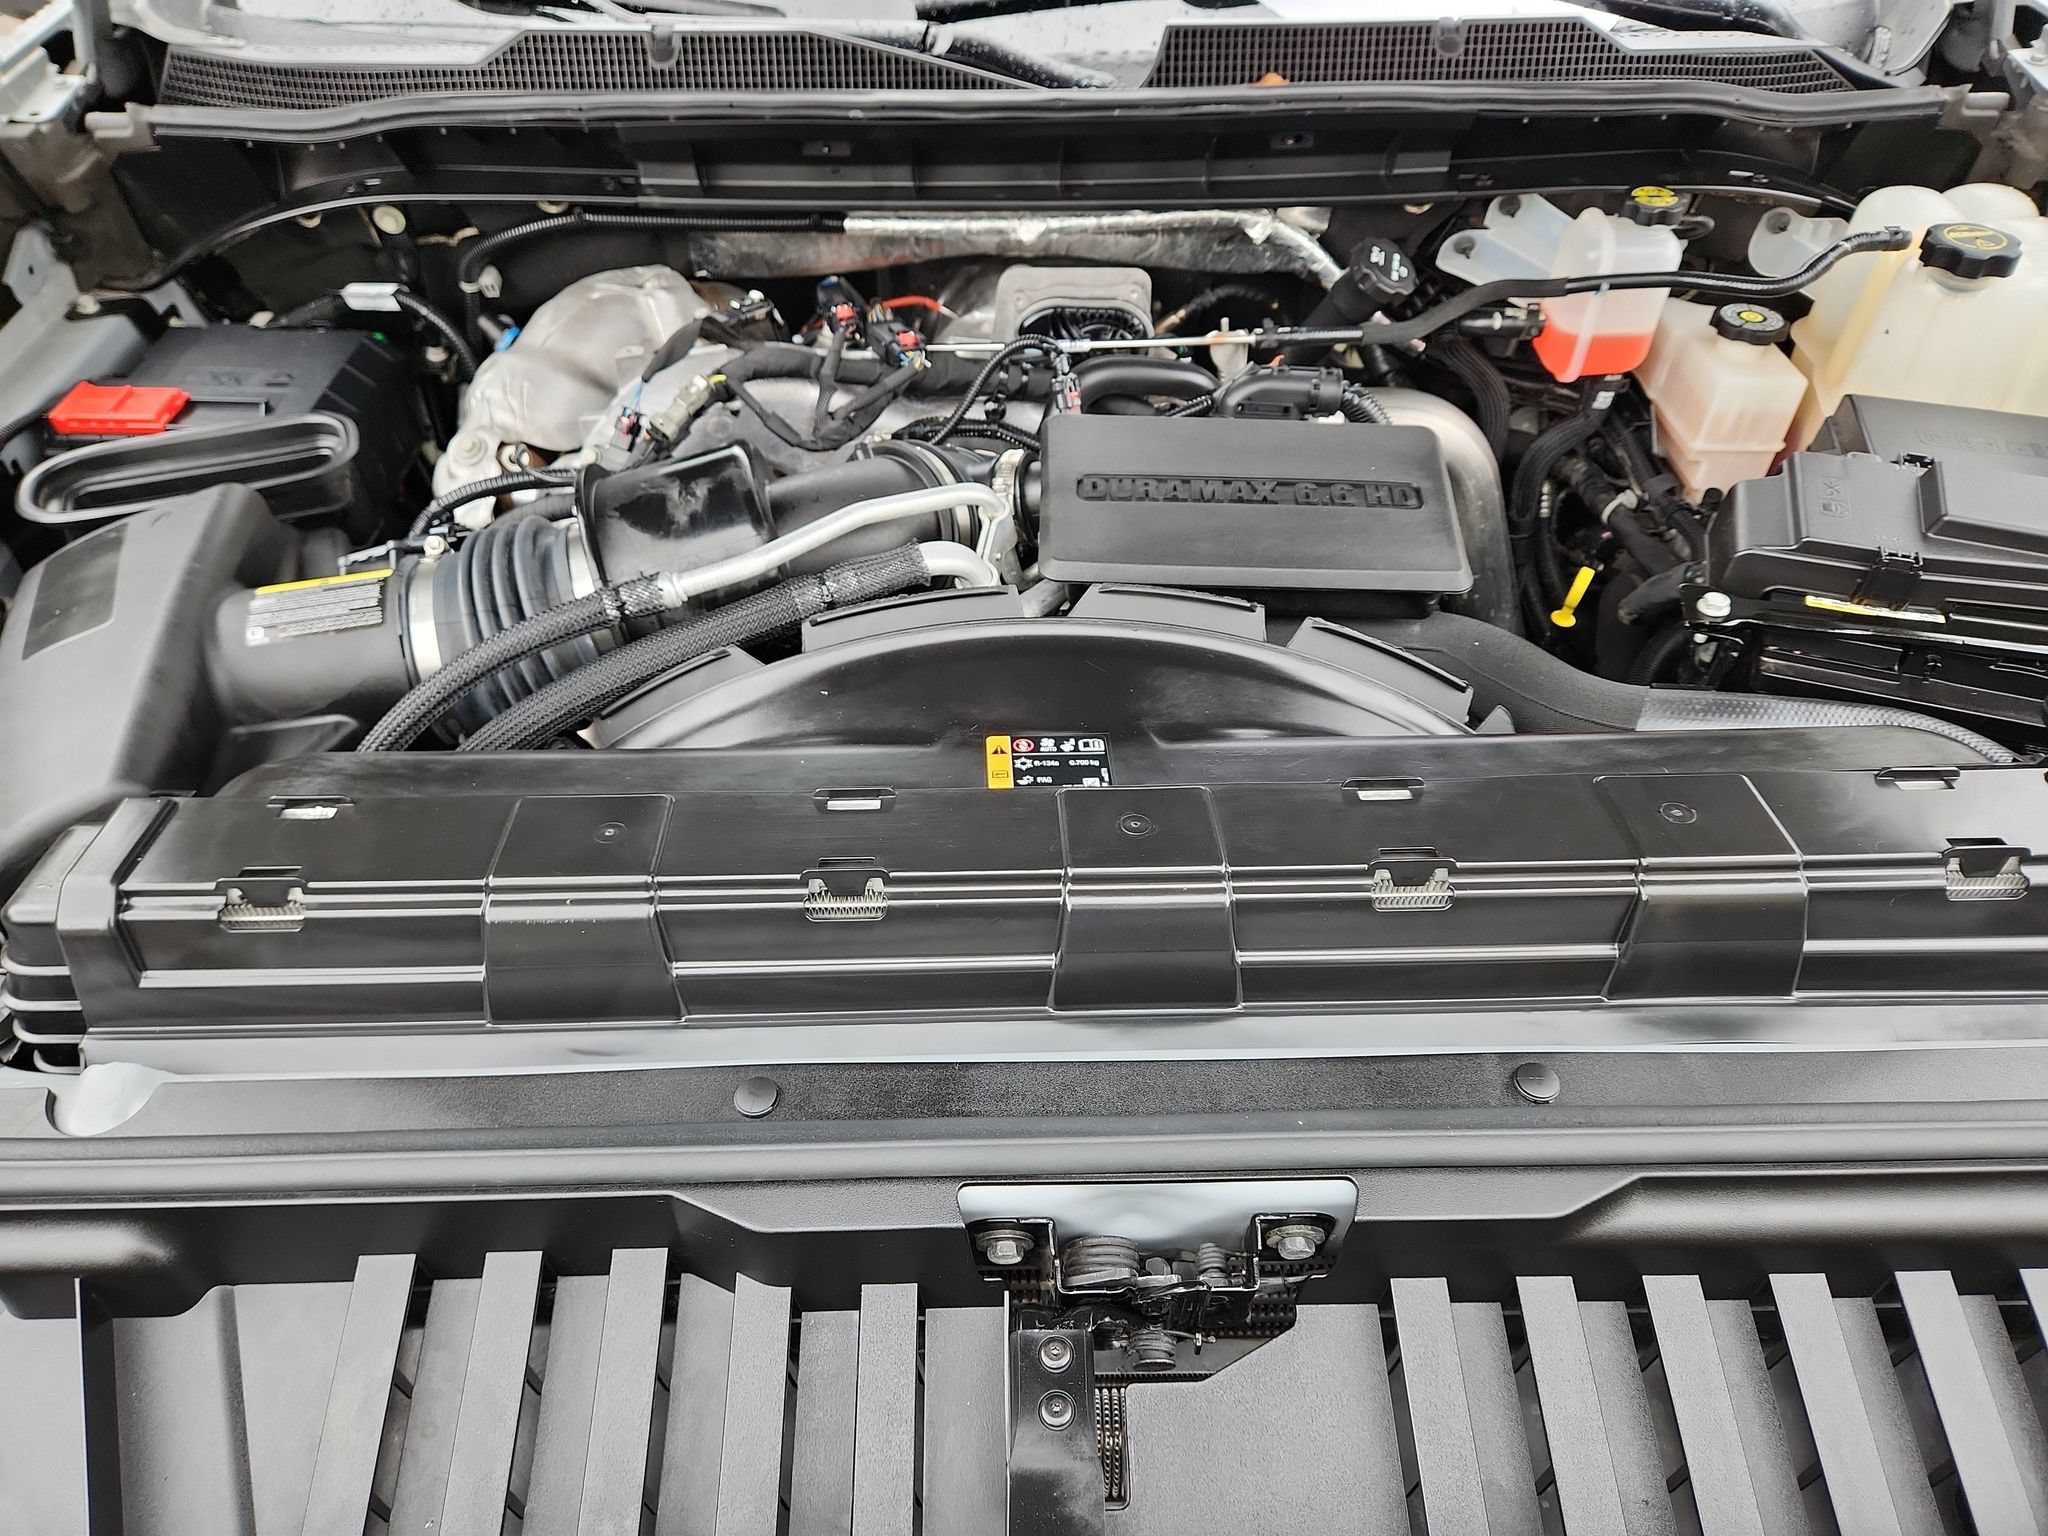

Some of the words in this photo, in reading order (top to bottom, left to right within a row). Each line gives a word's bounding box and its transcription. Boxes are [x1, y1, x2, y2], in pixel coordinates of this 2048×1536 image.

[1082, 477, 1279, 504] DURAMAX
[1294, 482, 1355, 506] 6.6
[1364, 484, 1420, 509] HD
